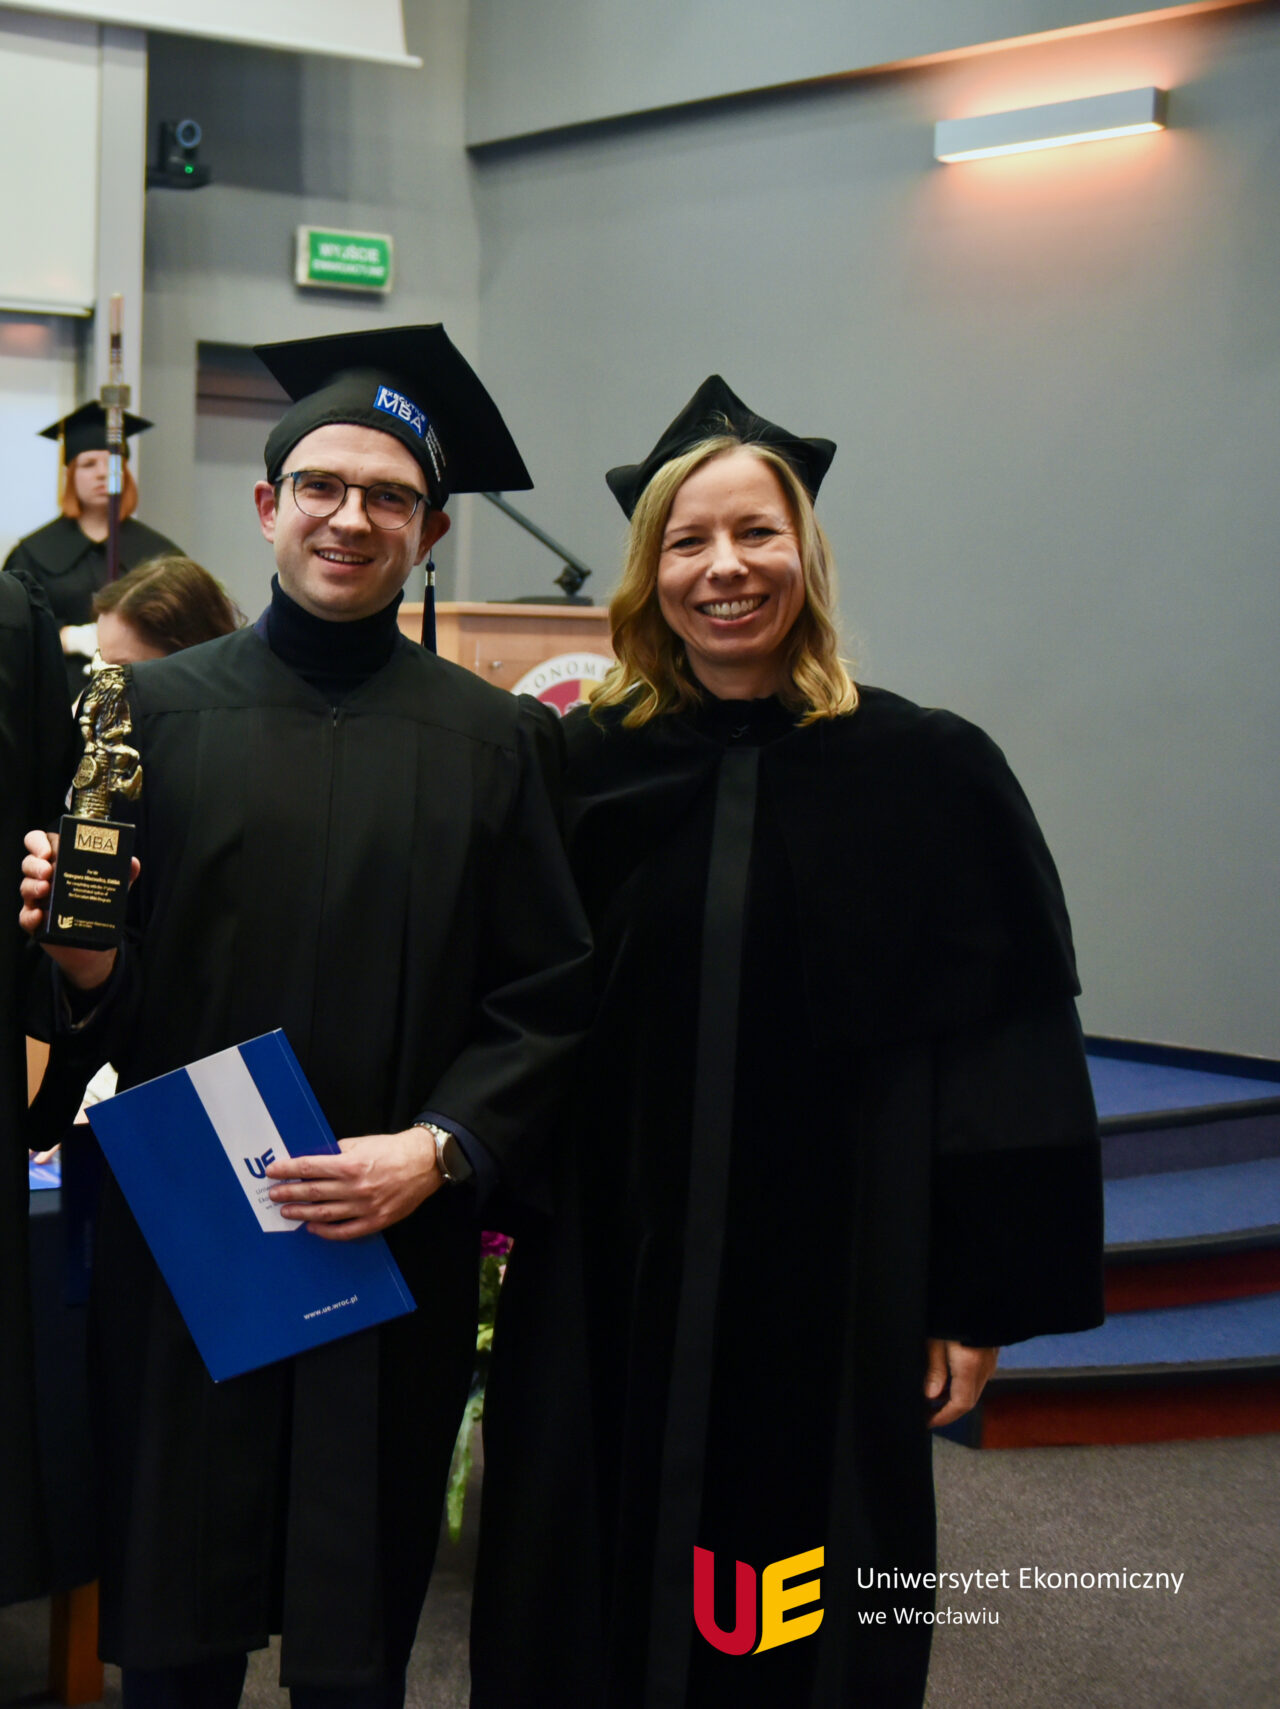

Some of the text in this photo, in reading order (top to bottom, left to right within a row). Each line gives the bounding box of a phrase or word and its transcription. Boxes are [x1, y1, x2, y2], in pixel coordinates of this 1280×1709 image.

[377, 393, 422, 434] MBA
[77, 833, 114, 851] MBA
[303, 1294, 358, 1320] www.ue.wroc.pl
